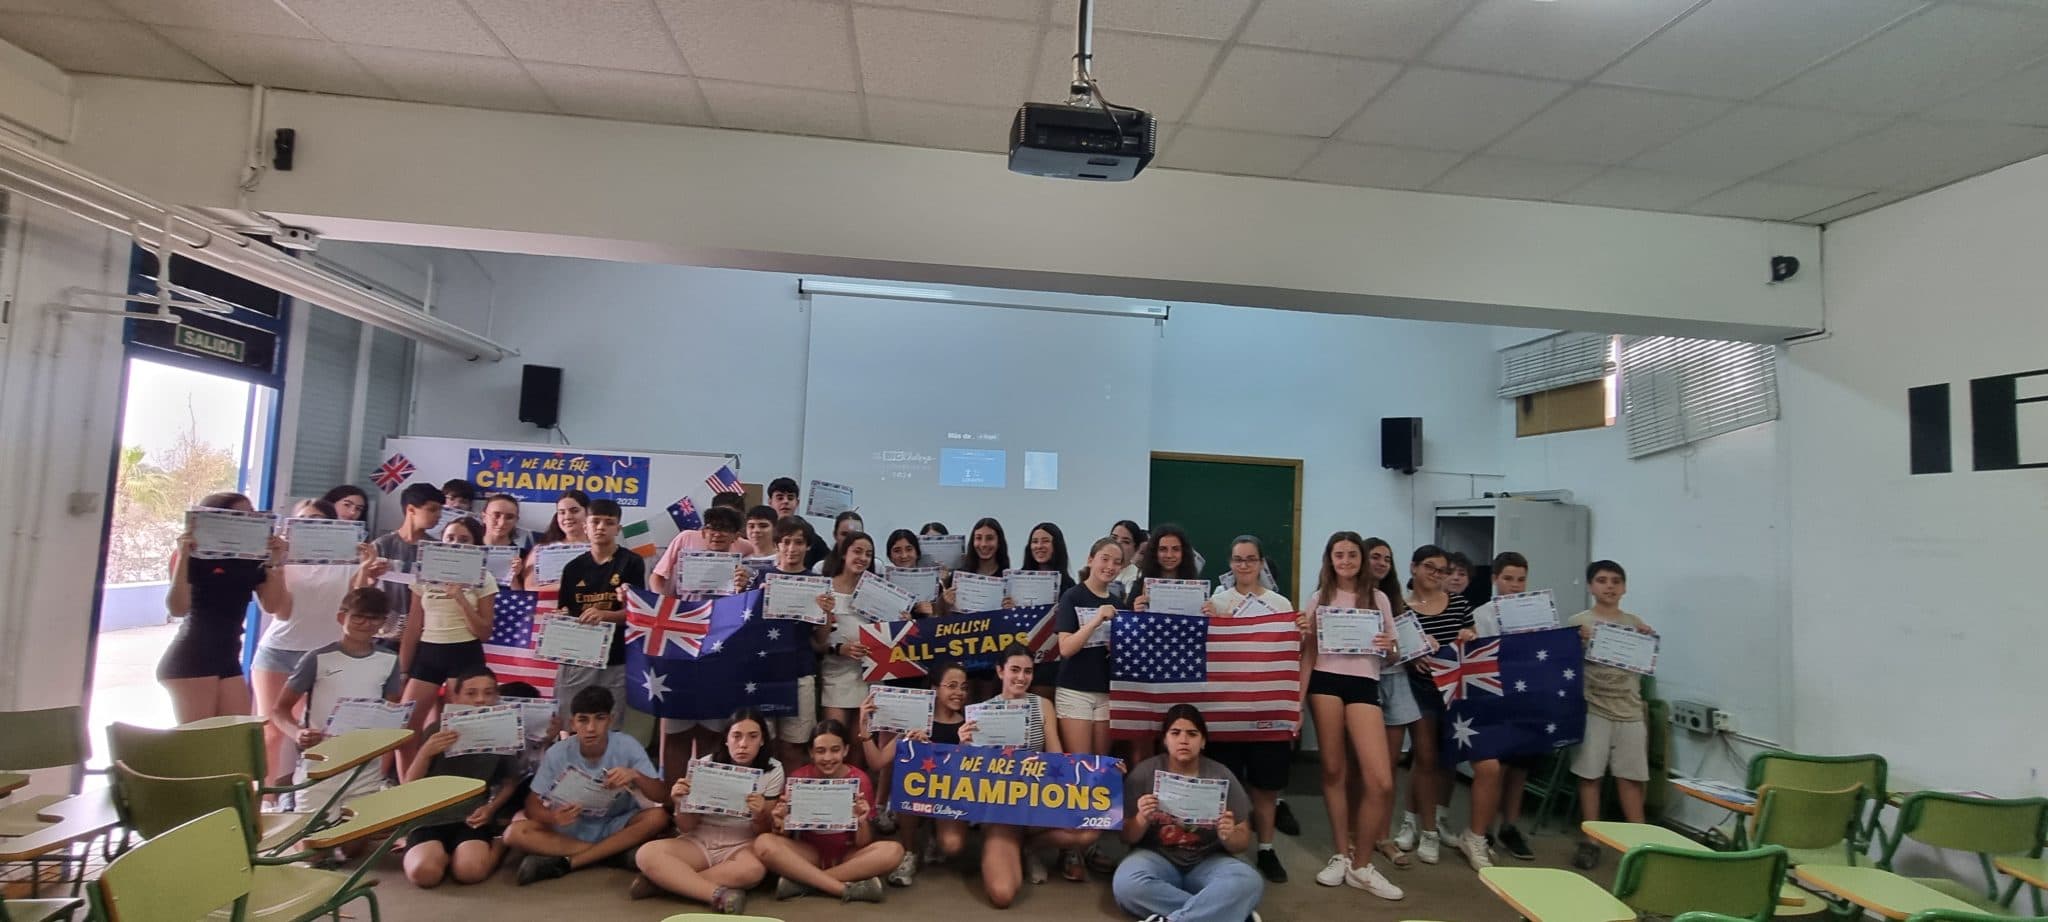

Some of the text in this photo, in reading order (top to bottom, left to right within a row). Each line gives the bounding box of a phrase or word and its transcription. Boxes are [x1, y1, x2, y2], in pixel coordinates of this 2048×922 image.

[184, 330, 236, 355] SALIDA
[521, 457, 592, 473] WE ARE THE
[475, 470, 639, 494] CHAMPIONS
[935, 618, 991, 638] ENGLISH
[960, 756, 1047, 777] WE ARE THE
[903, 771, 1111, 811] CHAMPIONS
[912, 802, 932, 813] BIG
[1082, 816, 1112, 828] 2026
